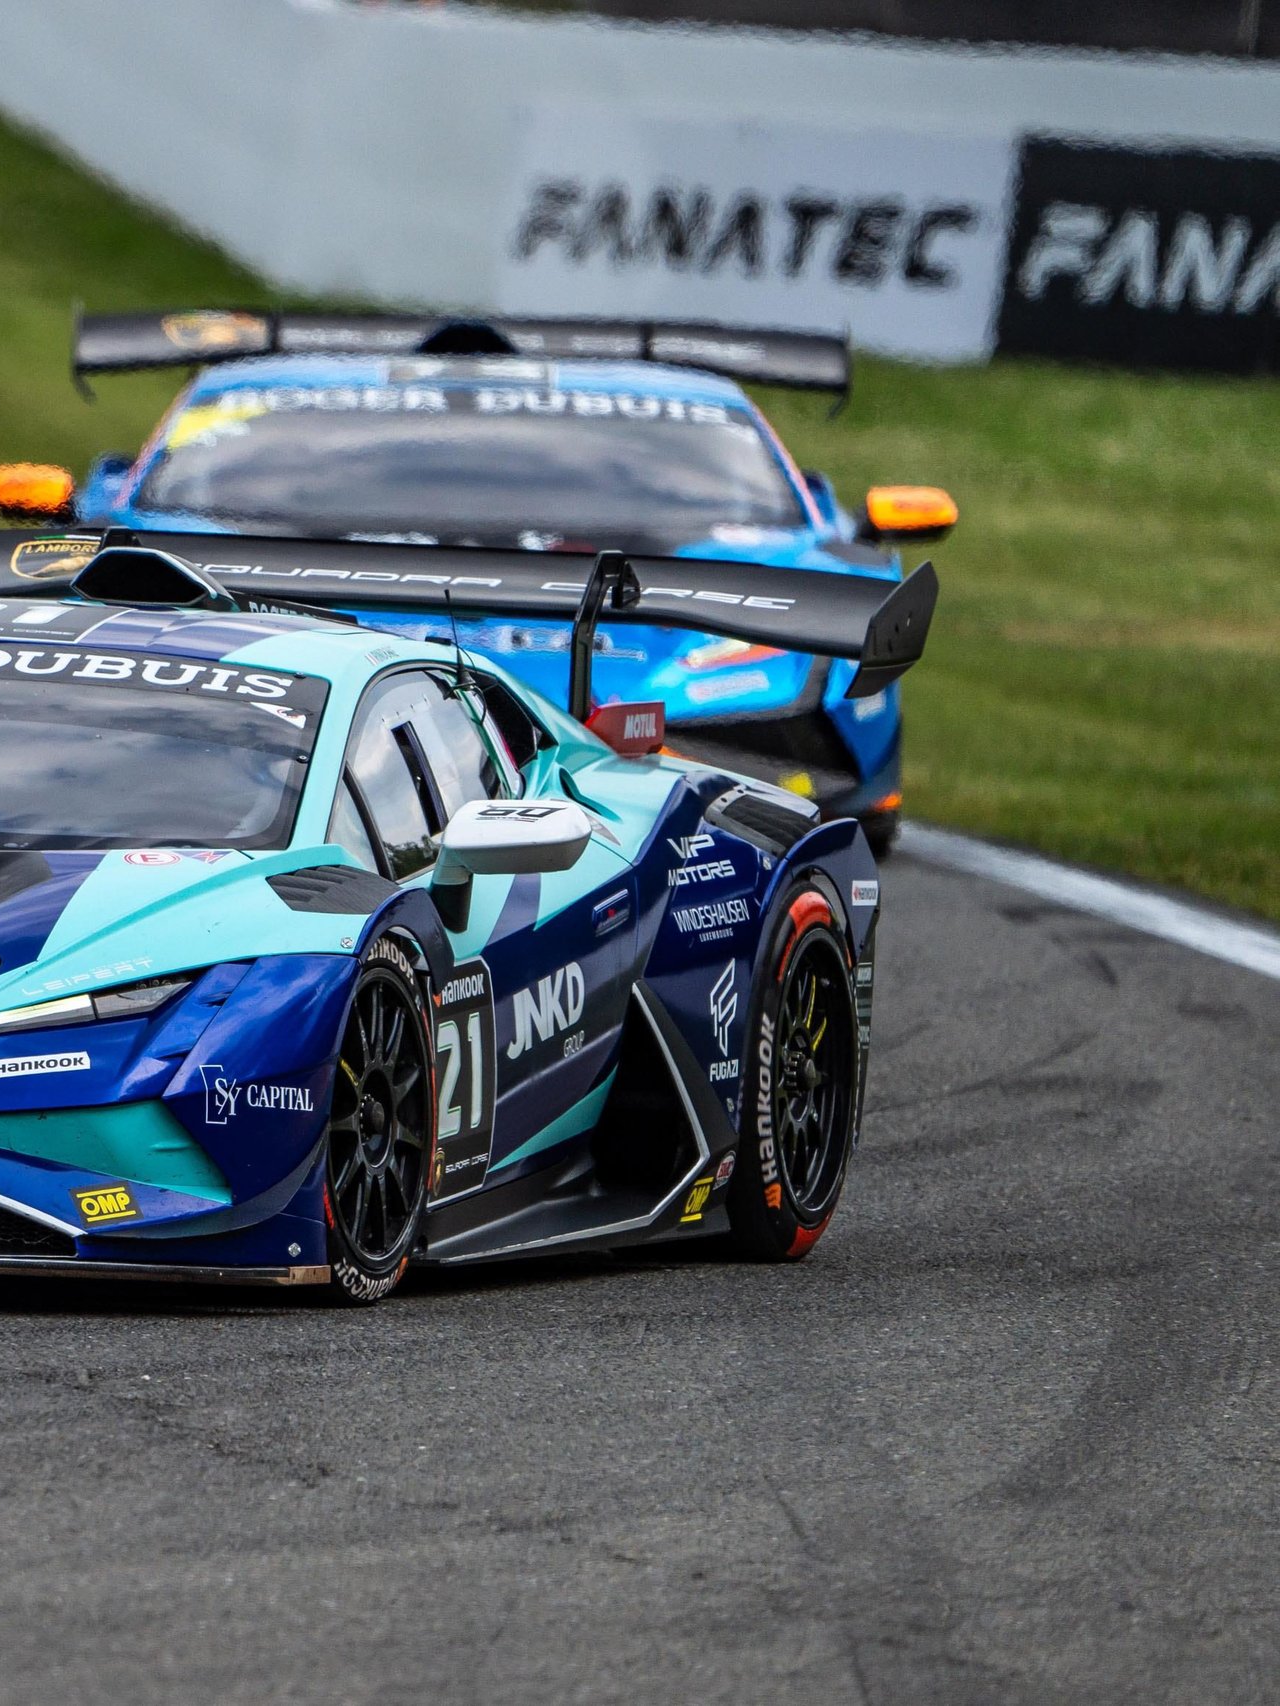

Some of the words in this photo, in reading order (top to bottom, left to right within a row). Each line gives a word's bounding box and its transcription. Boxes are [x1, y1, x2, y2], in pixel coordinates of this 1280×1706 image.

[515, 178, 979, 288] FANATEC
[196, 563, 503, 588] QUADRA
[541, 582, 796, 610] CRSE
[624, 713, 657, 740] MOTUL
[666, 833, 716, 860] VIP
[667, 859, 737, 887] MOTORS
[673, 898, 750, 933] WINDESHAUSEN
[21, 958, 154, 996] LEIPERT
[506, 961, 585, 1060] JNKD
[436, 1011, 483, 1140] 21
[709, 1058, 739, 1082] FUGAZI
[246, 1084, 314, 1112] CAPITAL
[81, 1192, 130, 1216] OMP
[684, 1184, 711, 1214] OMP
